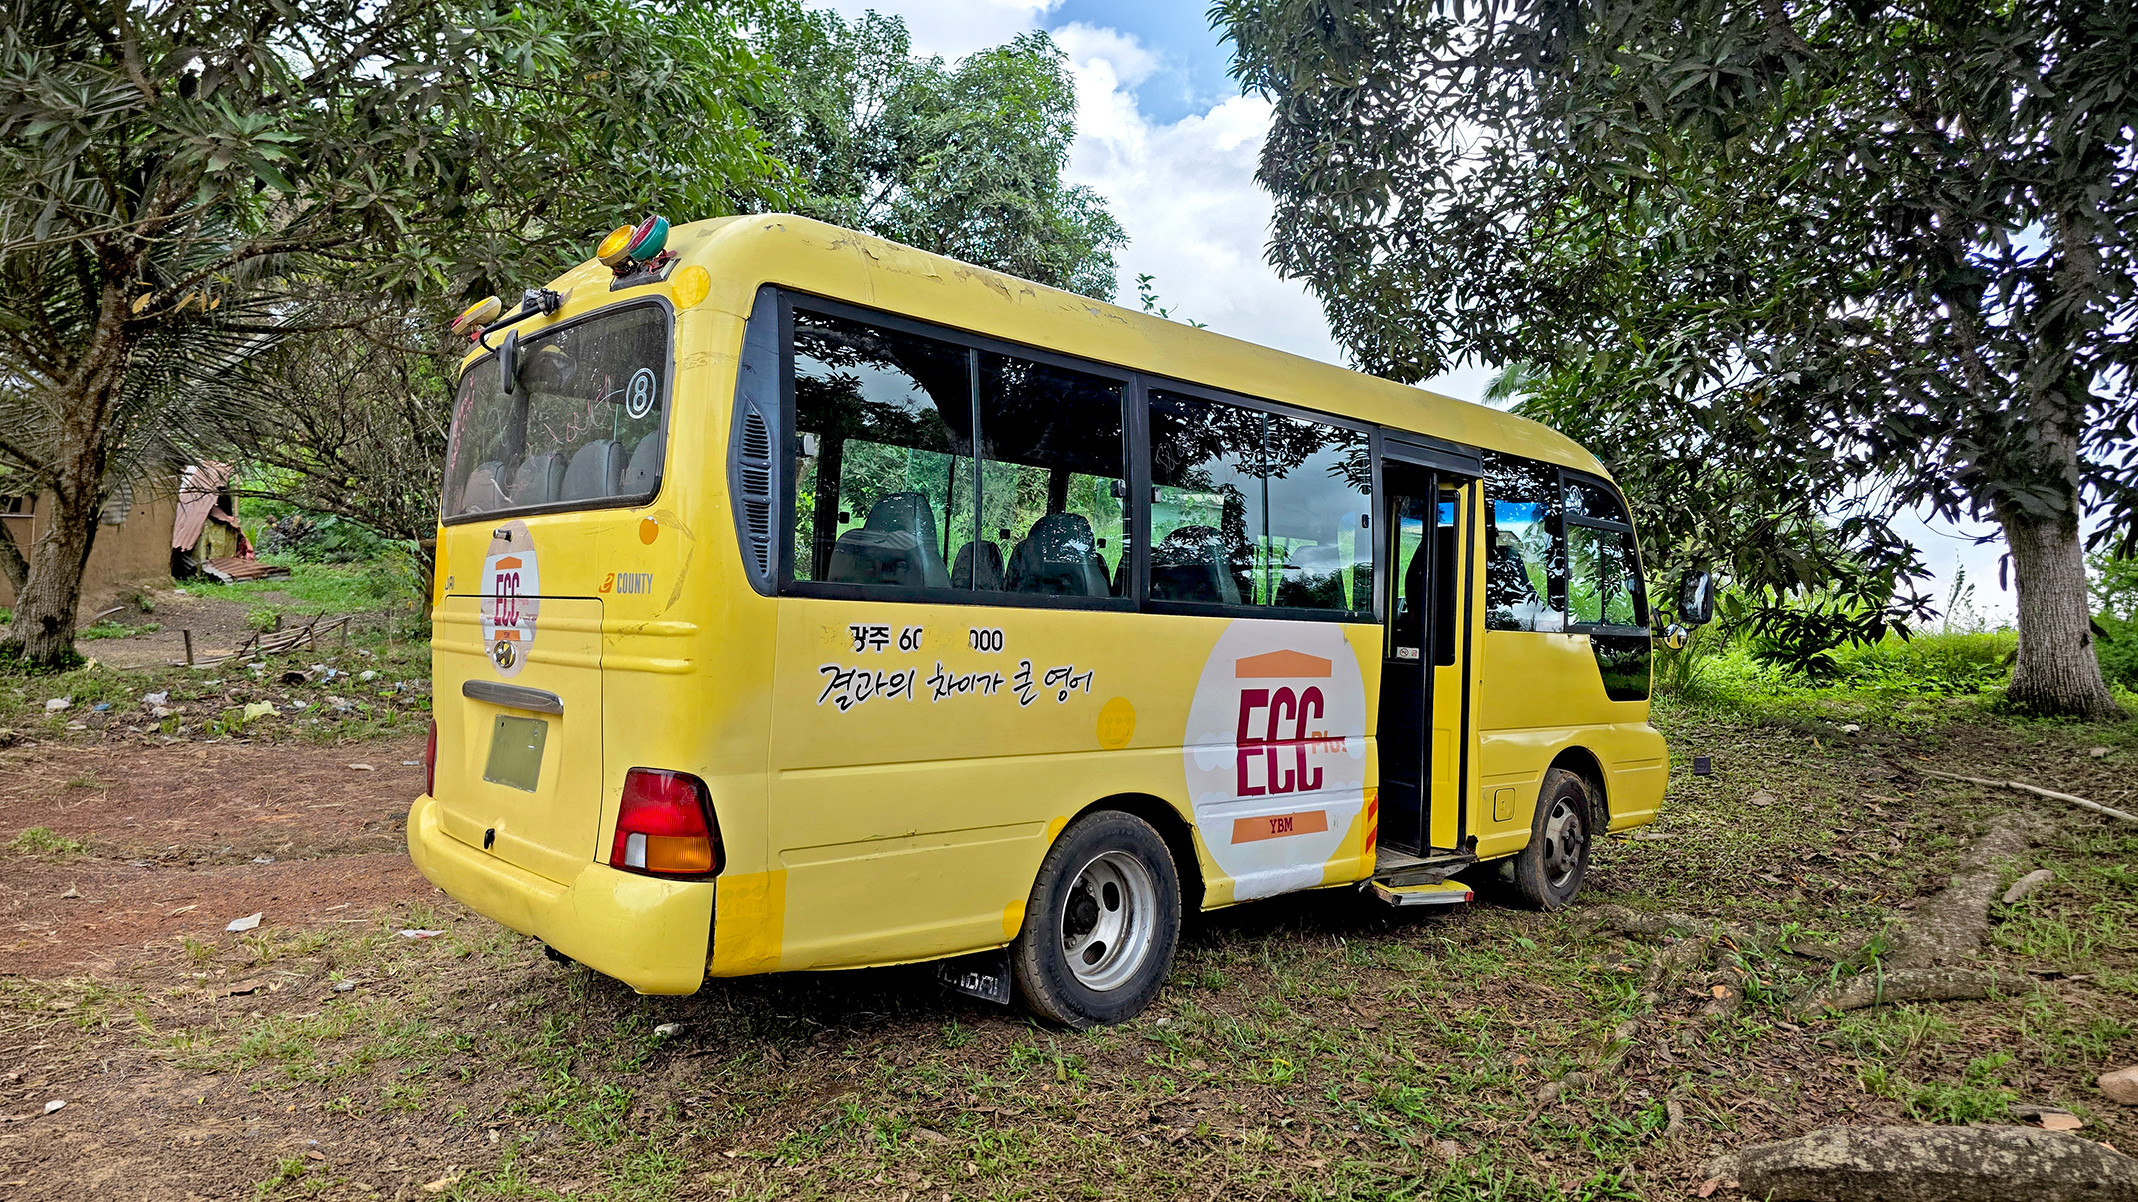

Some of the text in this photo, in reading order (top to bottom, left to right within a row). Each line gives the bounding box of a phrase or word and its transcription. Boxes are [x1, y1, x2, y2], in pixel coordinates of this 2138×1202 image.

[494, 572, 520, 626] ECC
[616, 572, 653, 594] COUNTY
[818, 661, 1094, 711] 결과의 차이가 큰 영어
[1236, 686, 1325, 797] ECC
[1269, 816, 1294, 834] YBM
